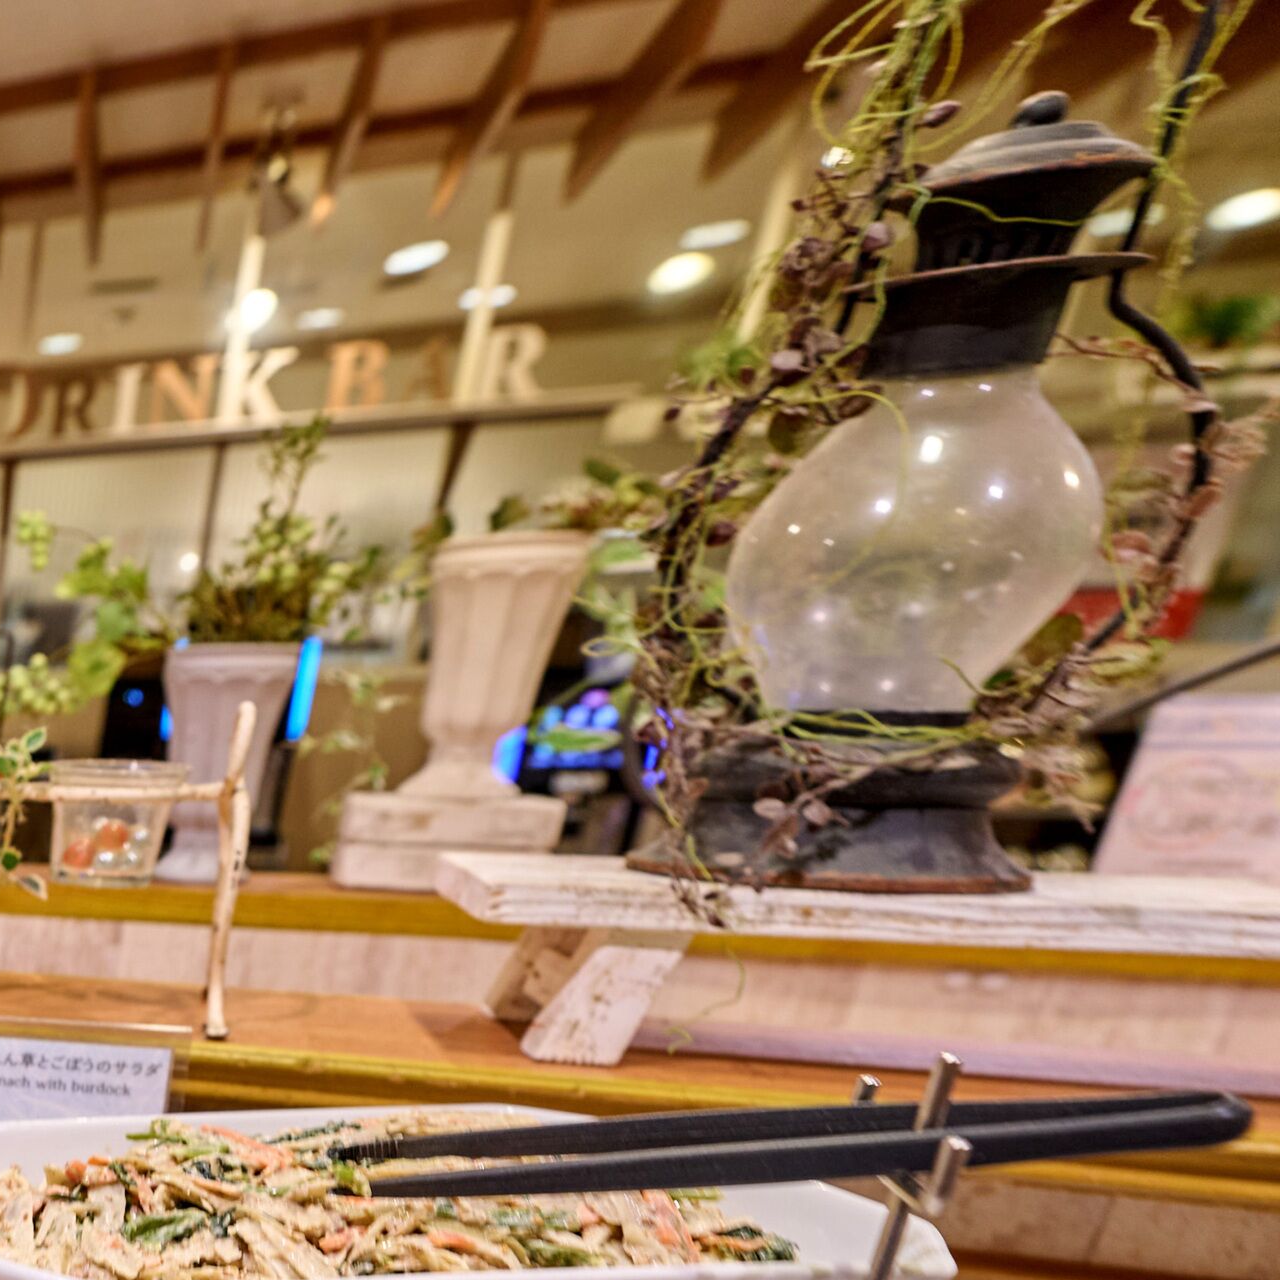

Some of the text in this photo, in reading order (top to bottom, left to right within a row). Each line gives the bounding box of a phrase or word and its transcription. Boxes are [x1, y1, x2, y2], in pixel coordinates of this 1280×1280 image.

[326, 322, 546, 412] BAR
[36, 1078, 67, 1092] with
[71, 1080, 131, 1097] burdock
